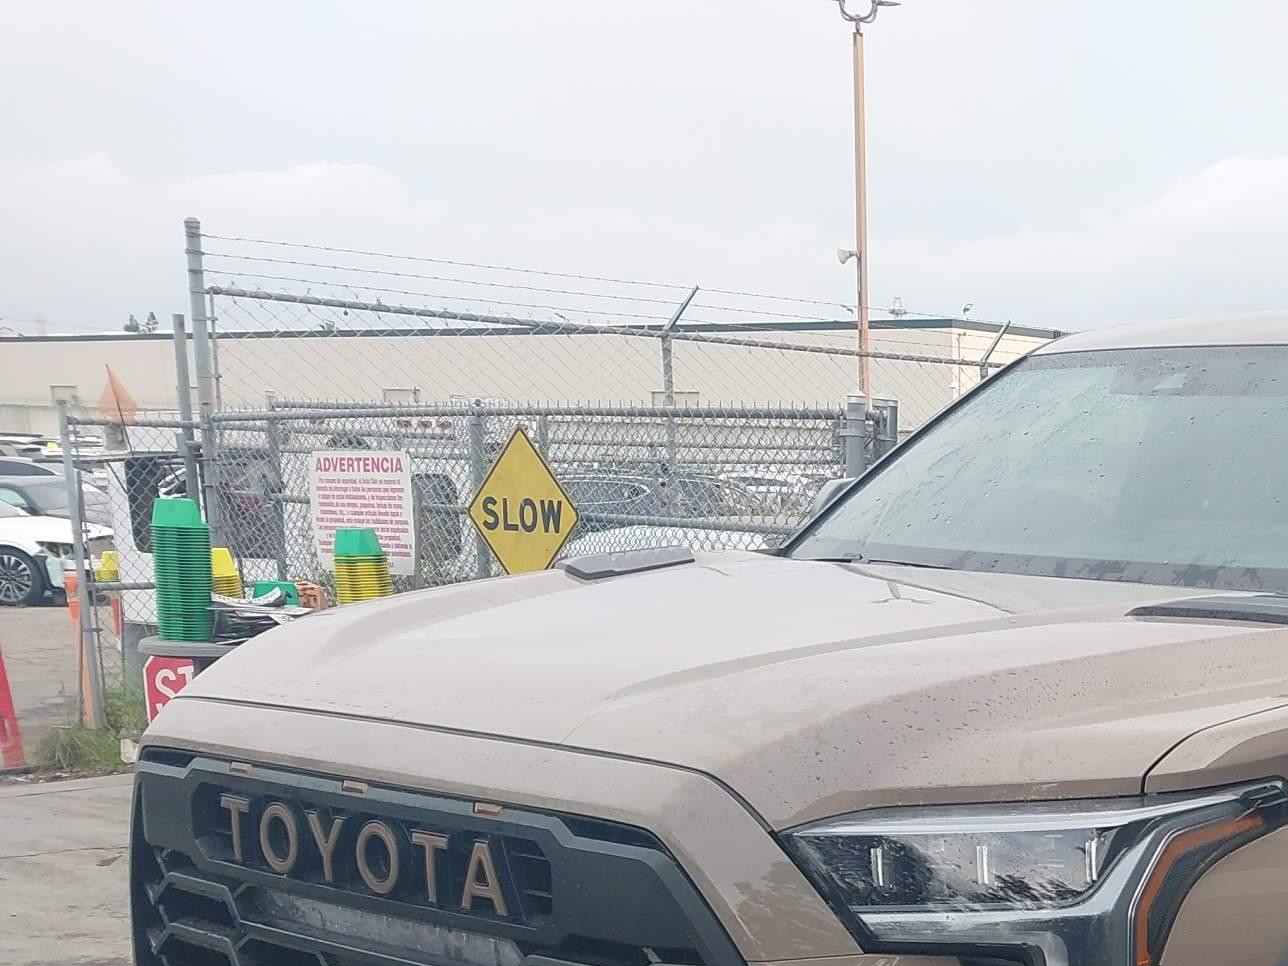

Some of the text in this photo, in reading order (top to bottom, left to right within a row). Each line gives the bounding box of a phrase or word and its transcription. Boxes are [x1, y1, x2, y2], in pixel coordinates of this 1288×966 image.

[315, 456, 404, 473] ADVERTENCIA
[482, 496, 563, 534] SLOW
[220, 793, 509, 917] TOYOTA
